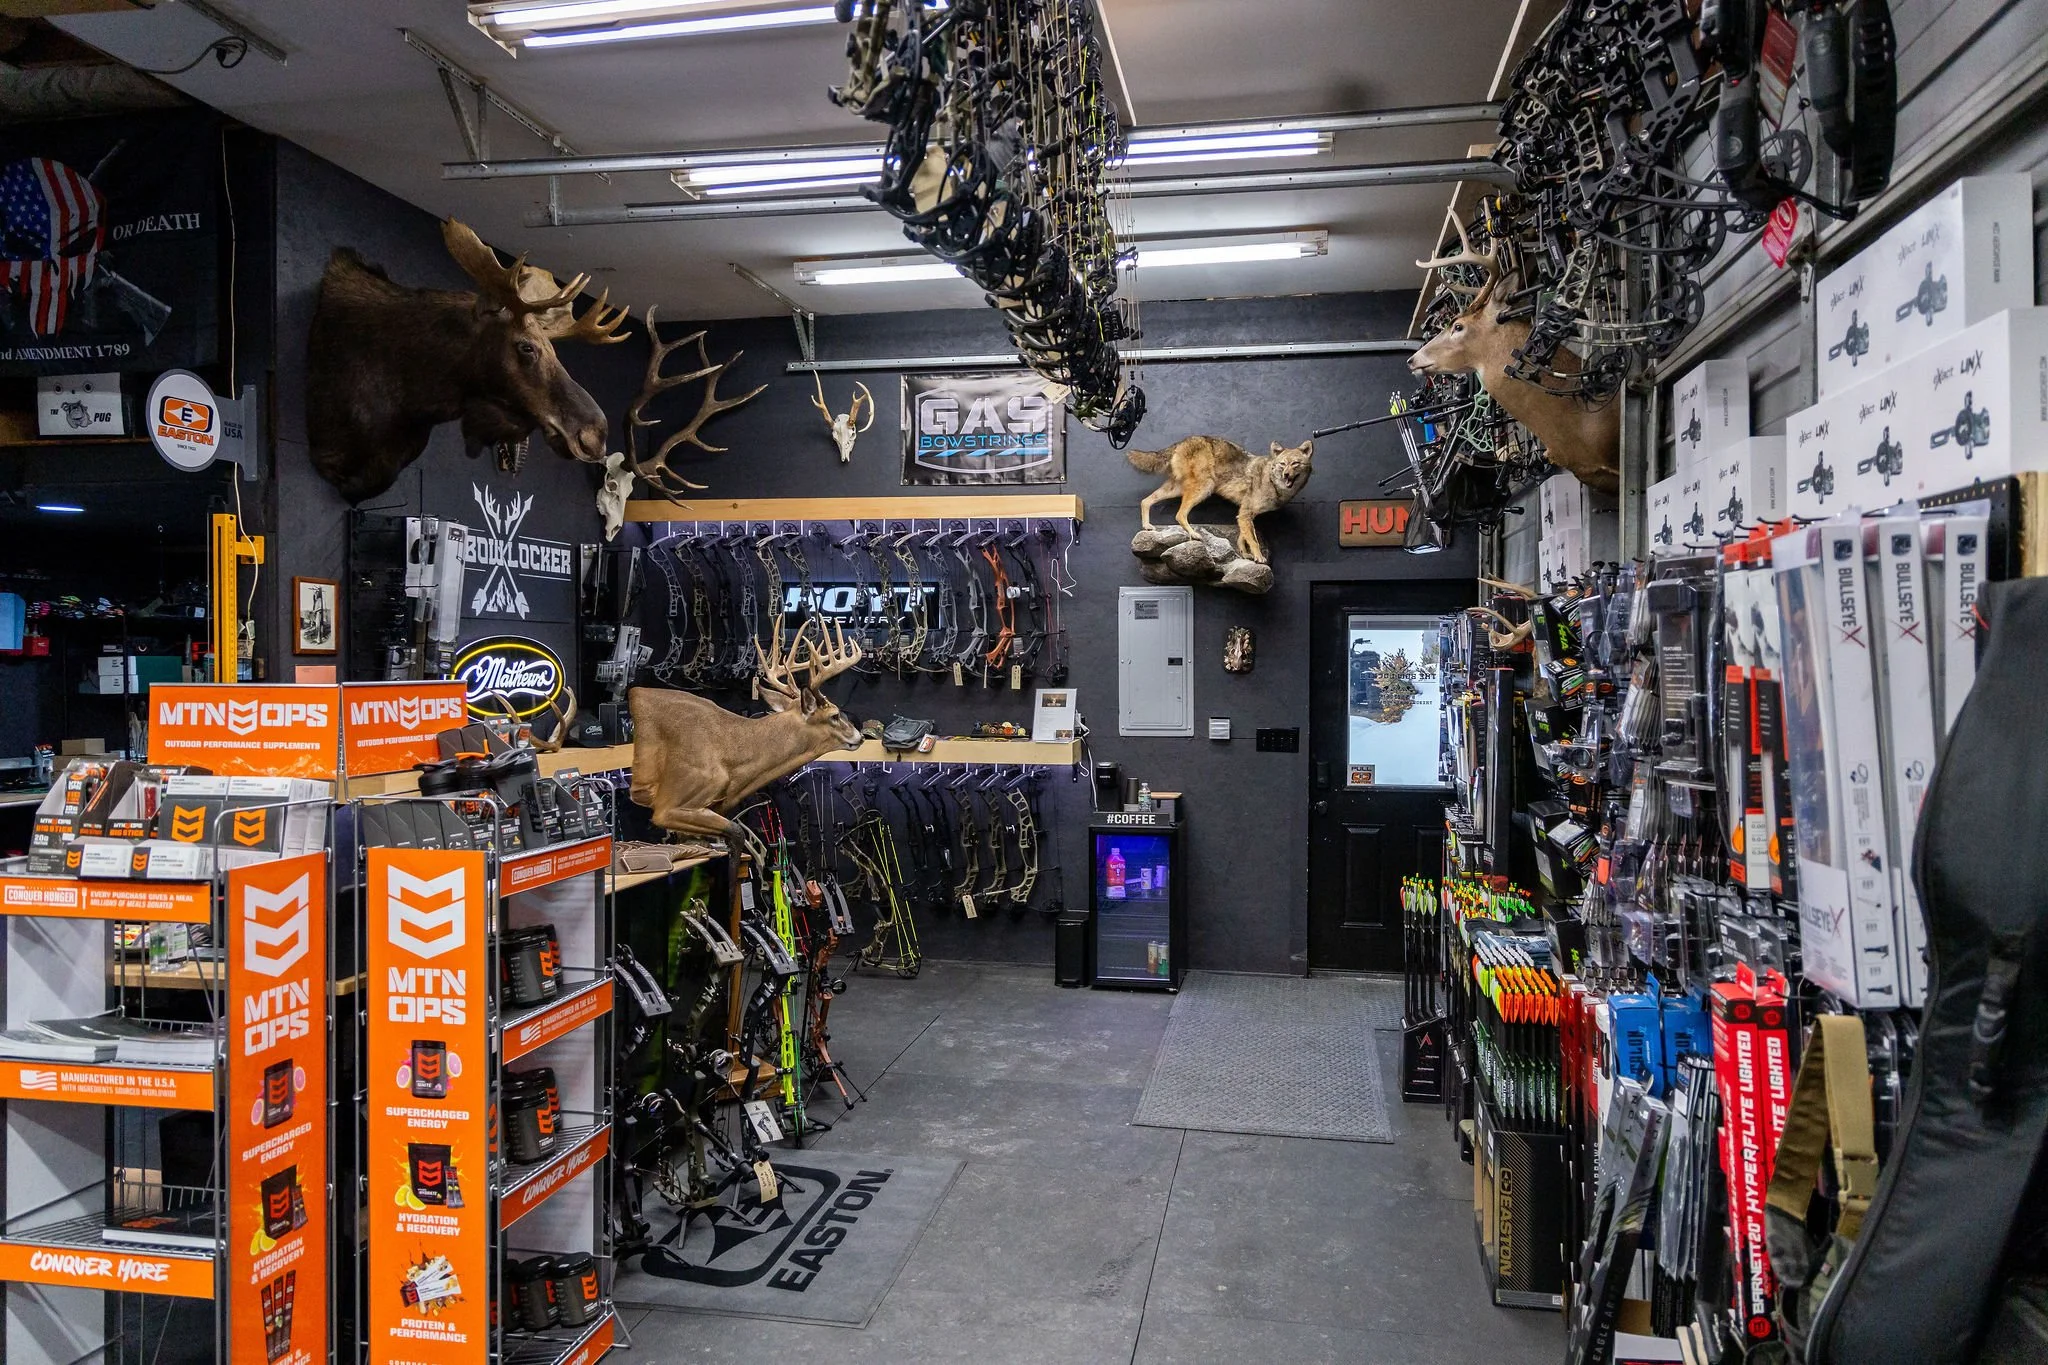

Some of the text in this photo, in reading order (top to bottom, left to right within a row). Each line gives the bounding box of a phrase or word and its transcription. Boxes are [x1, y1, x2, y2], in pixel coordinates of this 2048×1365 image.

[112, 212, 201, 241] OR DEATH
[15, 345, 91, 360] AMENDMENT
[96, 343, 130, 357] 1789
[93, 412, 111, 423] PUG
[181, 407, 192, 423] E
[920, 396, 1047, 435] GAS
[157, 424, 214, 446] EASTON
[224, 427, 243, 440] USA
[920, 432, 1048, 449] BOWSTRINGS
[464, 535, 571, 575] BOW LOCKER
[1838, 568, 1857, 628] BULLSEYE
[1896, 562, 1915, 623] BULLSEYE
[1960, 562, 1976, 624] BULLSEYE
[160, 702, 328, 727] MTN OPS
[350, 698, 462, 725] MTN OPS
[165, 740, 320, 750] OUTDOOR PERFORMANCE SUPPLEMENTS
[357, 738, 384, 747] OUTDOOR
[385, 736, 424, 745] PERFORMANCE
[1106, 814, 1156, 825] #COFFEE
[8, 889, 74, 903] CONQUER HUNGER
[90, 891, 111, 899] EVERY
[112, 892, 147, 900] PURCHASE
[388, 966, 466, 996] MTN
[245, 978, 310, 1024] MTN
[388, 996, 466, 1025] OPS
[245, 1007, 310, 1057] OPS
[60, 1072, 177, 1088] MANUFACTURED IN THE U.S.A.
[1767, 1037, 1785, 1099] LIGHTED
[386, 1107, 469, 1120] SUPERCHARGED
[407, 1118, 448, 1129] ENERGY
[242, 1122, 312, 1161] SUPERCHARGED
[260, 1140, 295, 1164] ENERGY
[523, 1164, 566, 1205] CONQUER
[566, 1145, 592, 1176] MORE
[1737, 1030, 1765, 1314] BARNETT 20" HYPERFLITE LIGHTED
[396, 1223, 460, 1236] & RECOVERY
[398, 1213, 458, 1226] HYDRATION
[766, 1169, 889, 1293] EASTON
[1500, 1195, 1513, 1277] EASTON
[30, 1250, 171, 1283] CONQUER MORE
[251, 1246, 305, 1285] & RECOVERY
[253, 1236, 303, 1273] HYDRATION
[389, 1328, 468, 1343] PERFORMANCE
[401, 1318, 456, 1332] PROTEIN &
[1593, 1325, 1611, 1362] EAGLE
